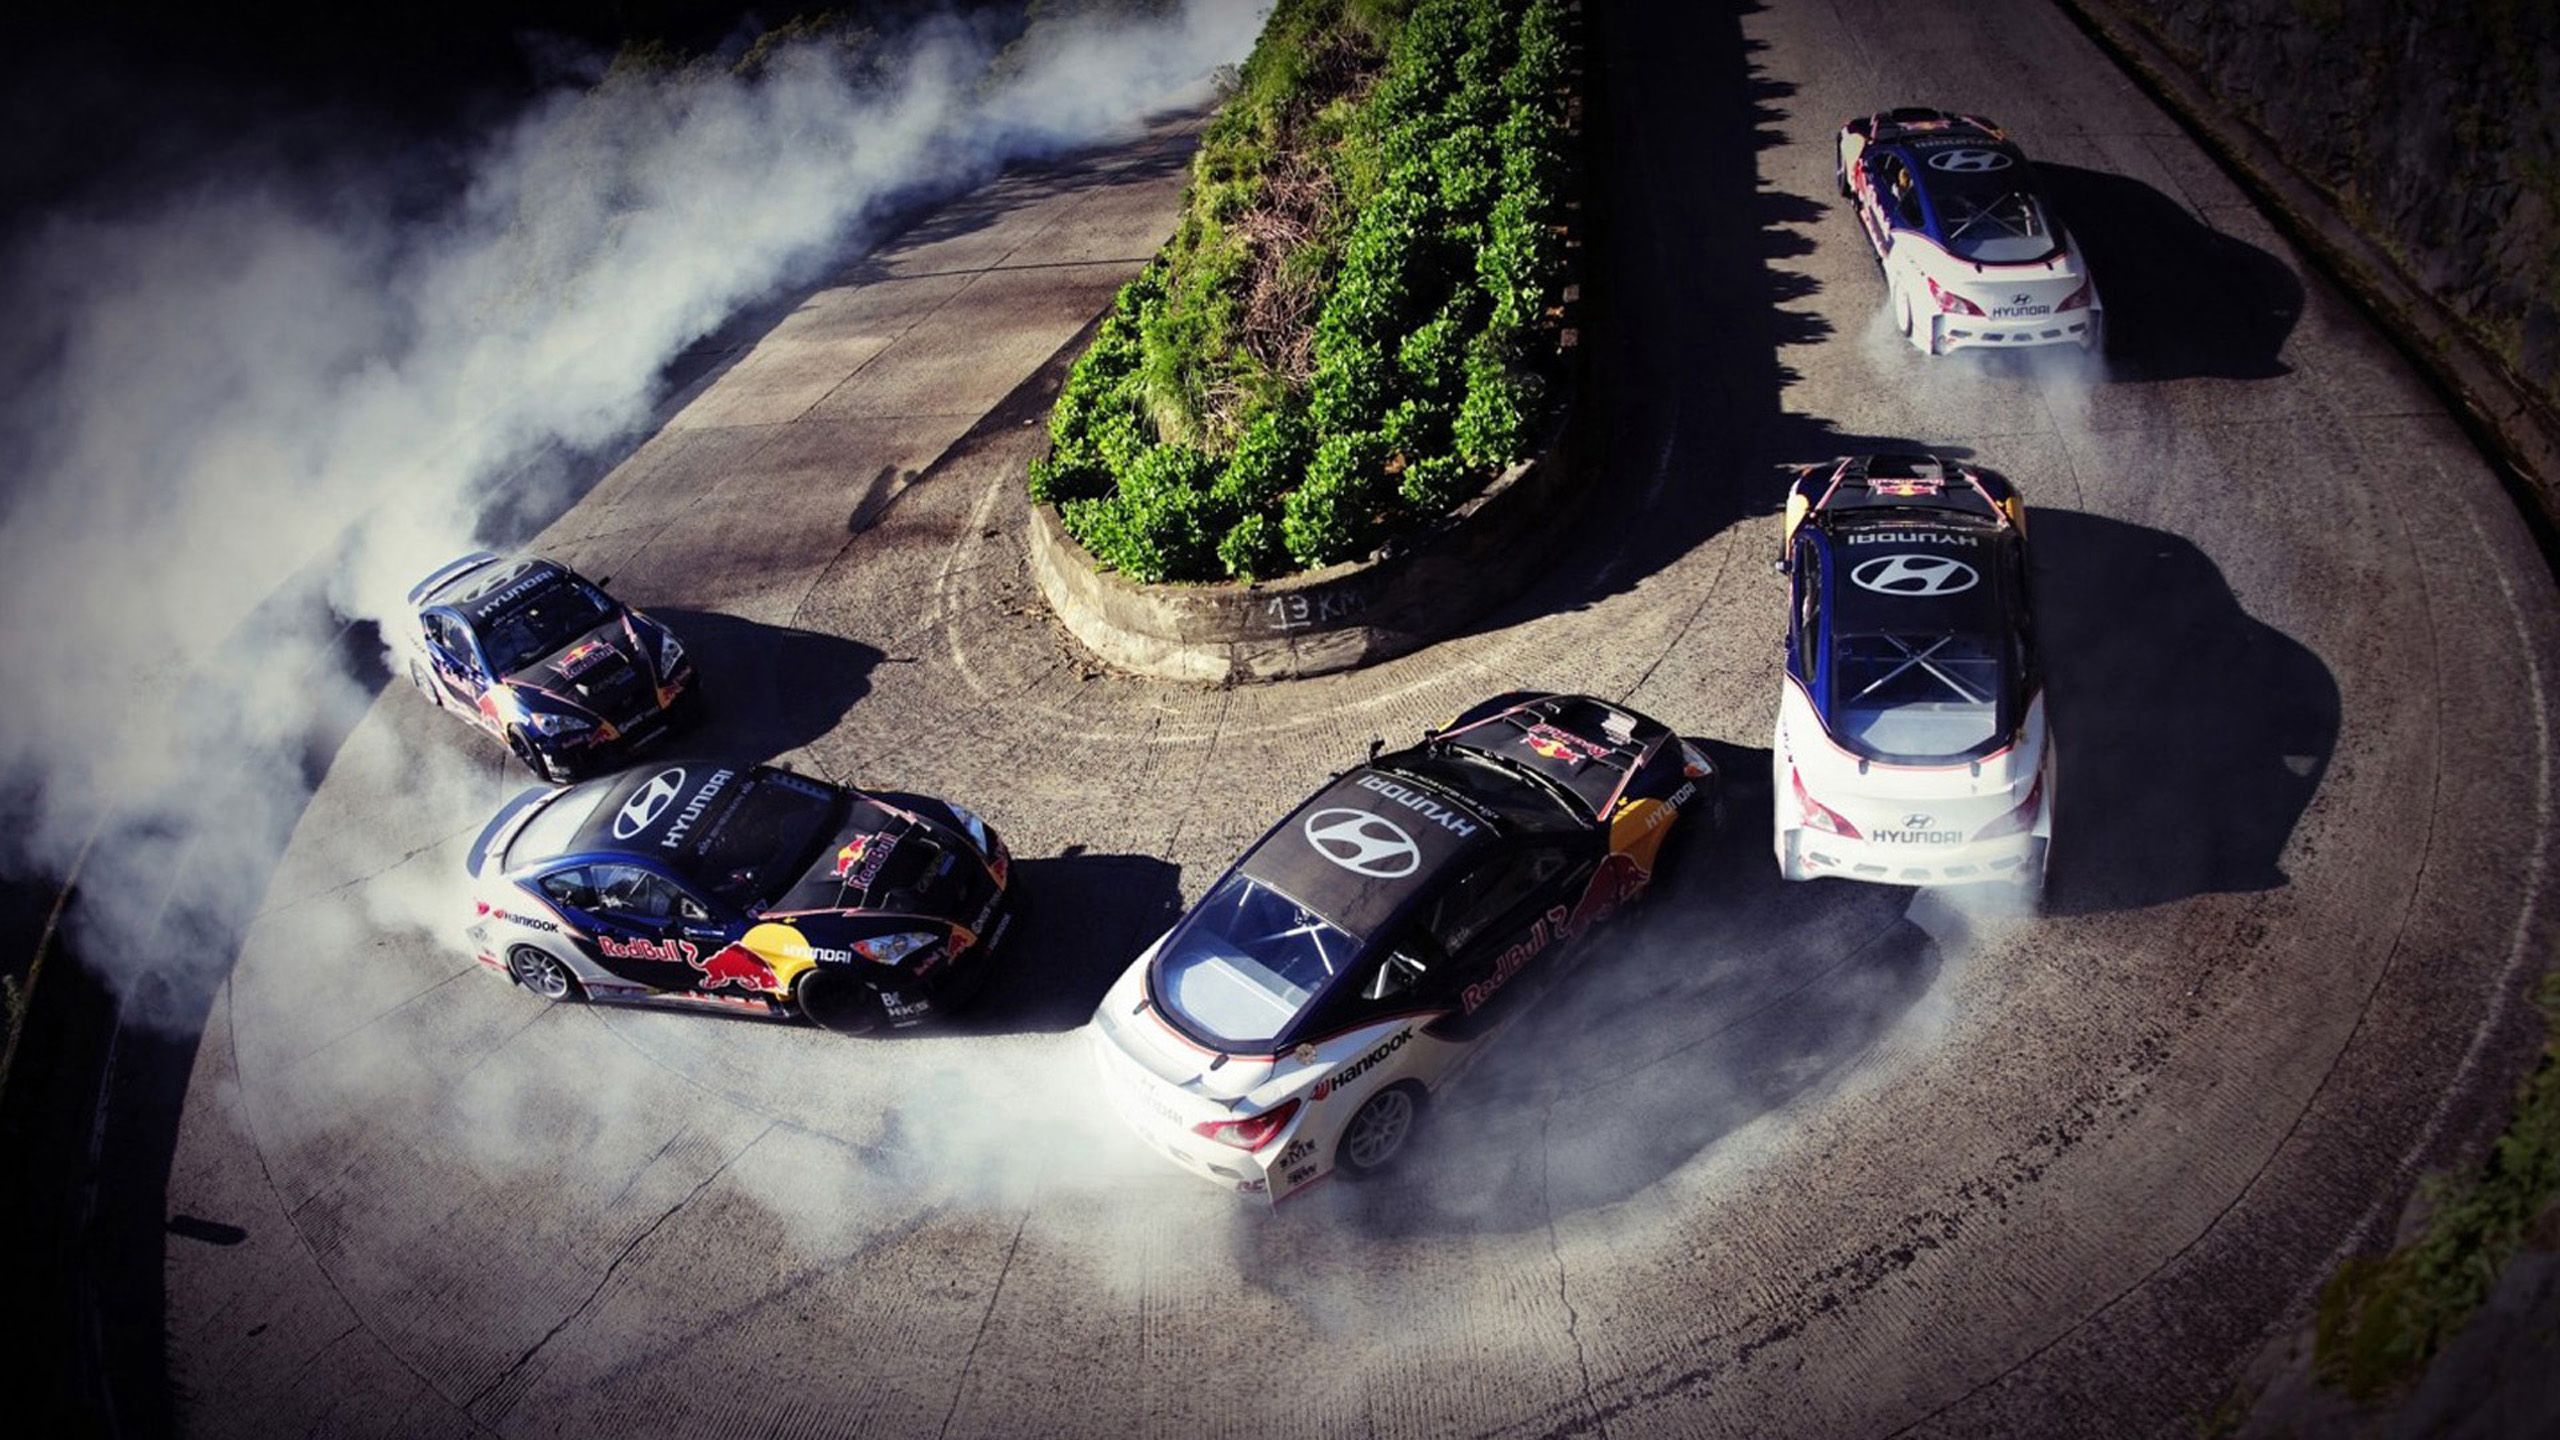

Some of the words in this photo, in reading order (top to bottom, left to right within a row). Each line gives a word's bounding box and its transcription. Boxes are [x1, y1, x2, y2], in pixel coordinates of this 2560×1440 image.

[1993, 304, 2050, 317] HYUNDAI
[1849, 532, 1979, 547] HYUNDAI
[477, 570, 555, 617] HYUNDAI
[1268, 594, 1310, 629] 13
[661, 768, 735, 849] HYUNDAI
[1356, 774, 1477, 840] HYUNDAI
[1645, 781, 1697, 829] HYUNDAI
[1873, 830, 1962, 844] HYUNDAI
